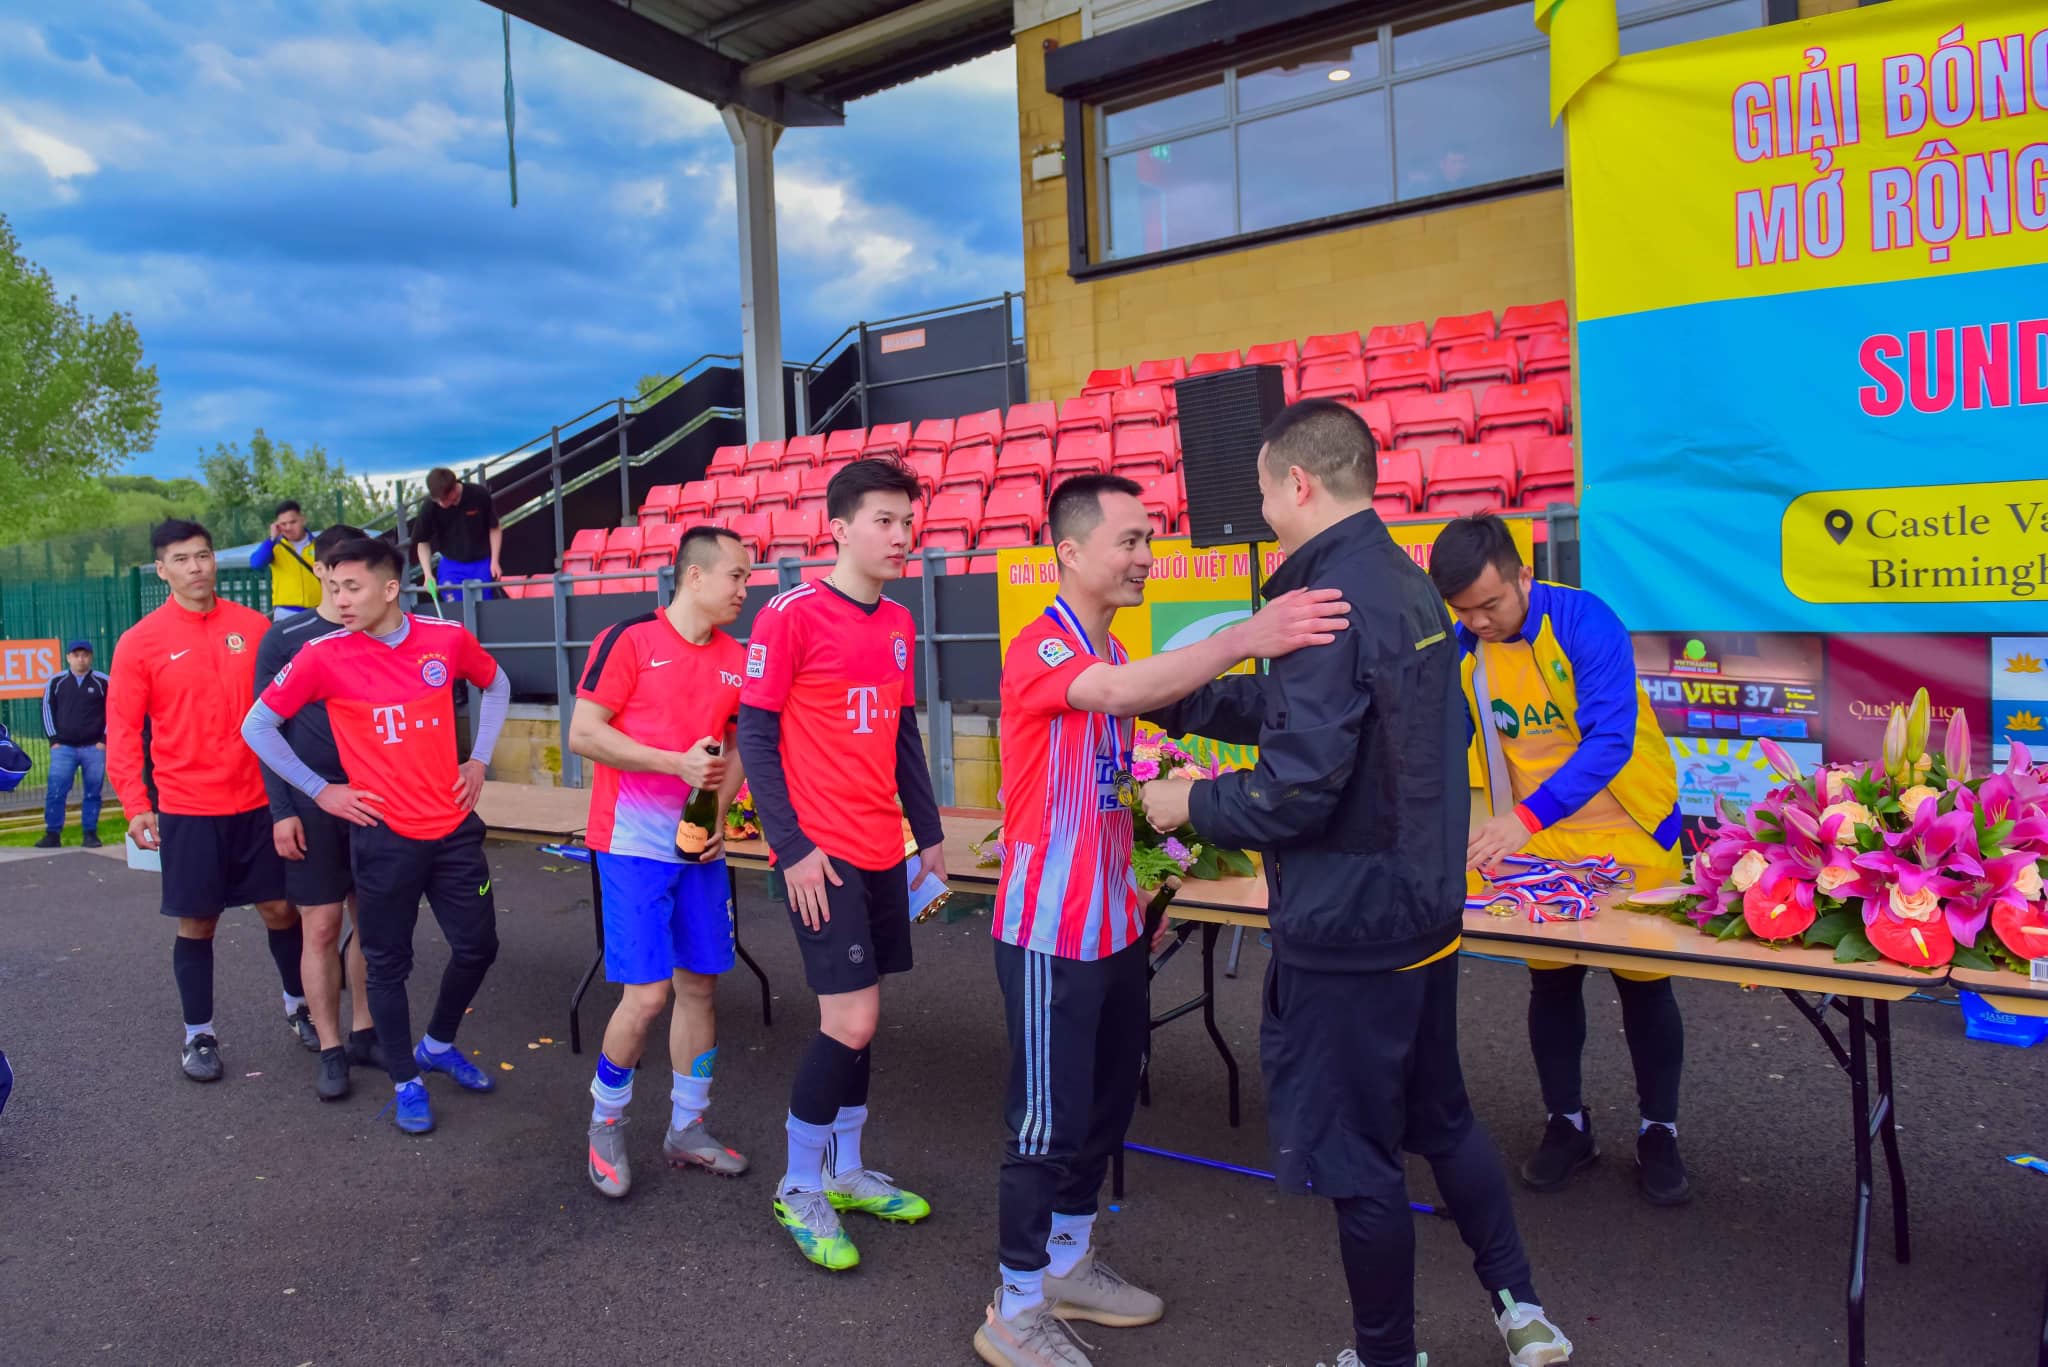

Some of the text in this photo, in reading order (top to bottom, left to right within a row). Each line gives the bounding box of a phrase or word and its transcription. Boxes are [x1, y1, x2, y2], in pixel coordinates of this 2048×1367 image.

[1732, 46, 1860, 163] GIẢI
[1736, 138, 2048, 269] MỞ RỘNG
[1866, 504, 1990, 539] Castle
[1010, 554, 1035, 585] GIẢI
[1039, 557, 1062, 584] BÓ
[1148, 550, 1188, 580] GƯỜI
[1193, 549, 1228, 583] VIỆT
[1232, 553, 1249, 578] M
[0, 647, 54, 681] ETS
[1744, 686, 1774, 707] 37
